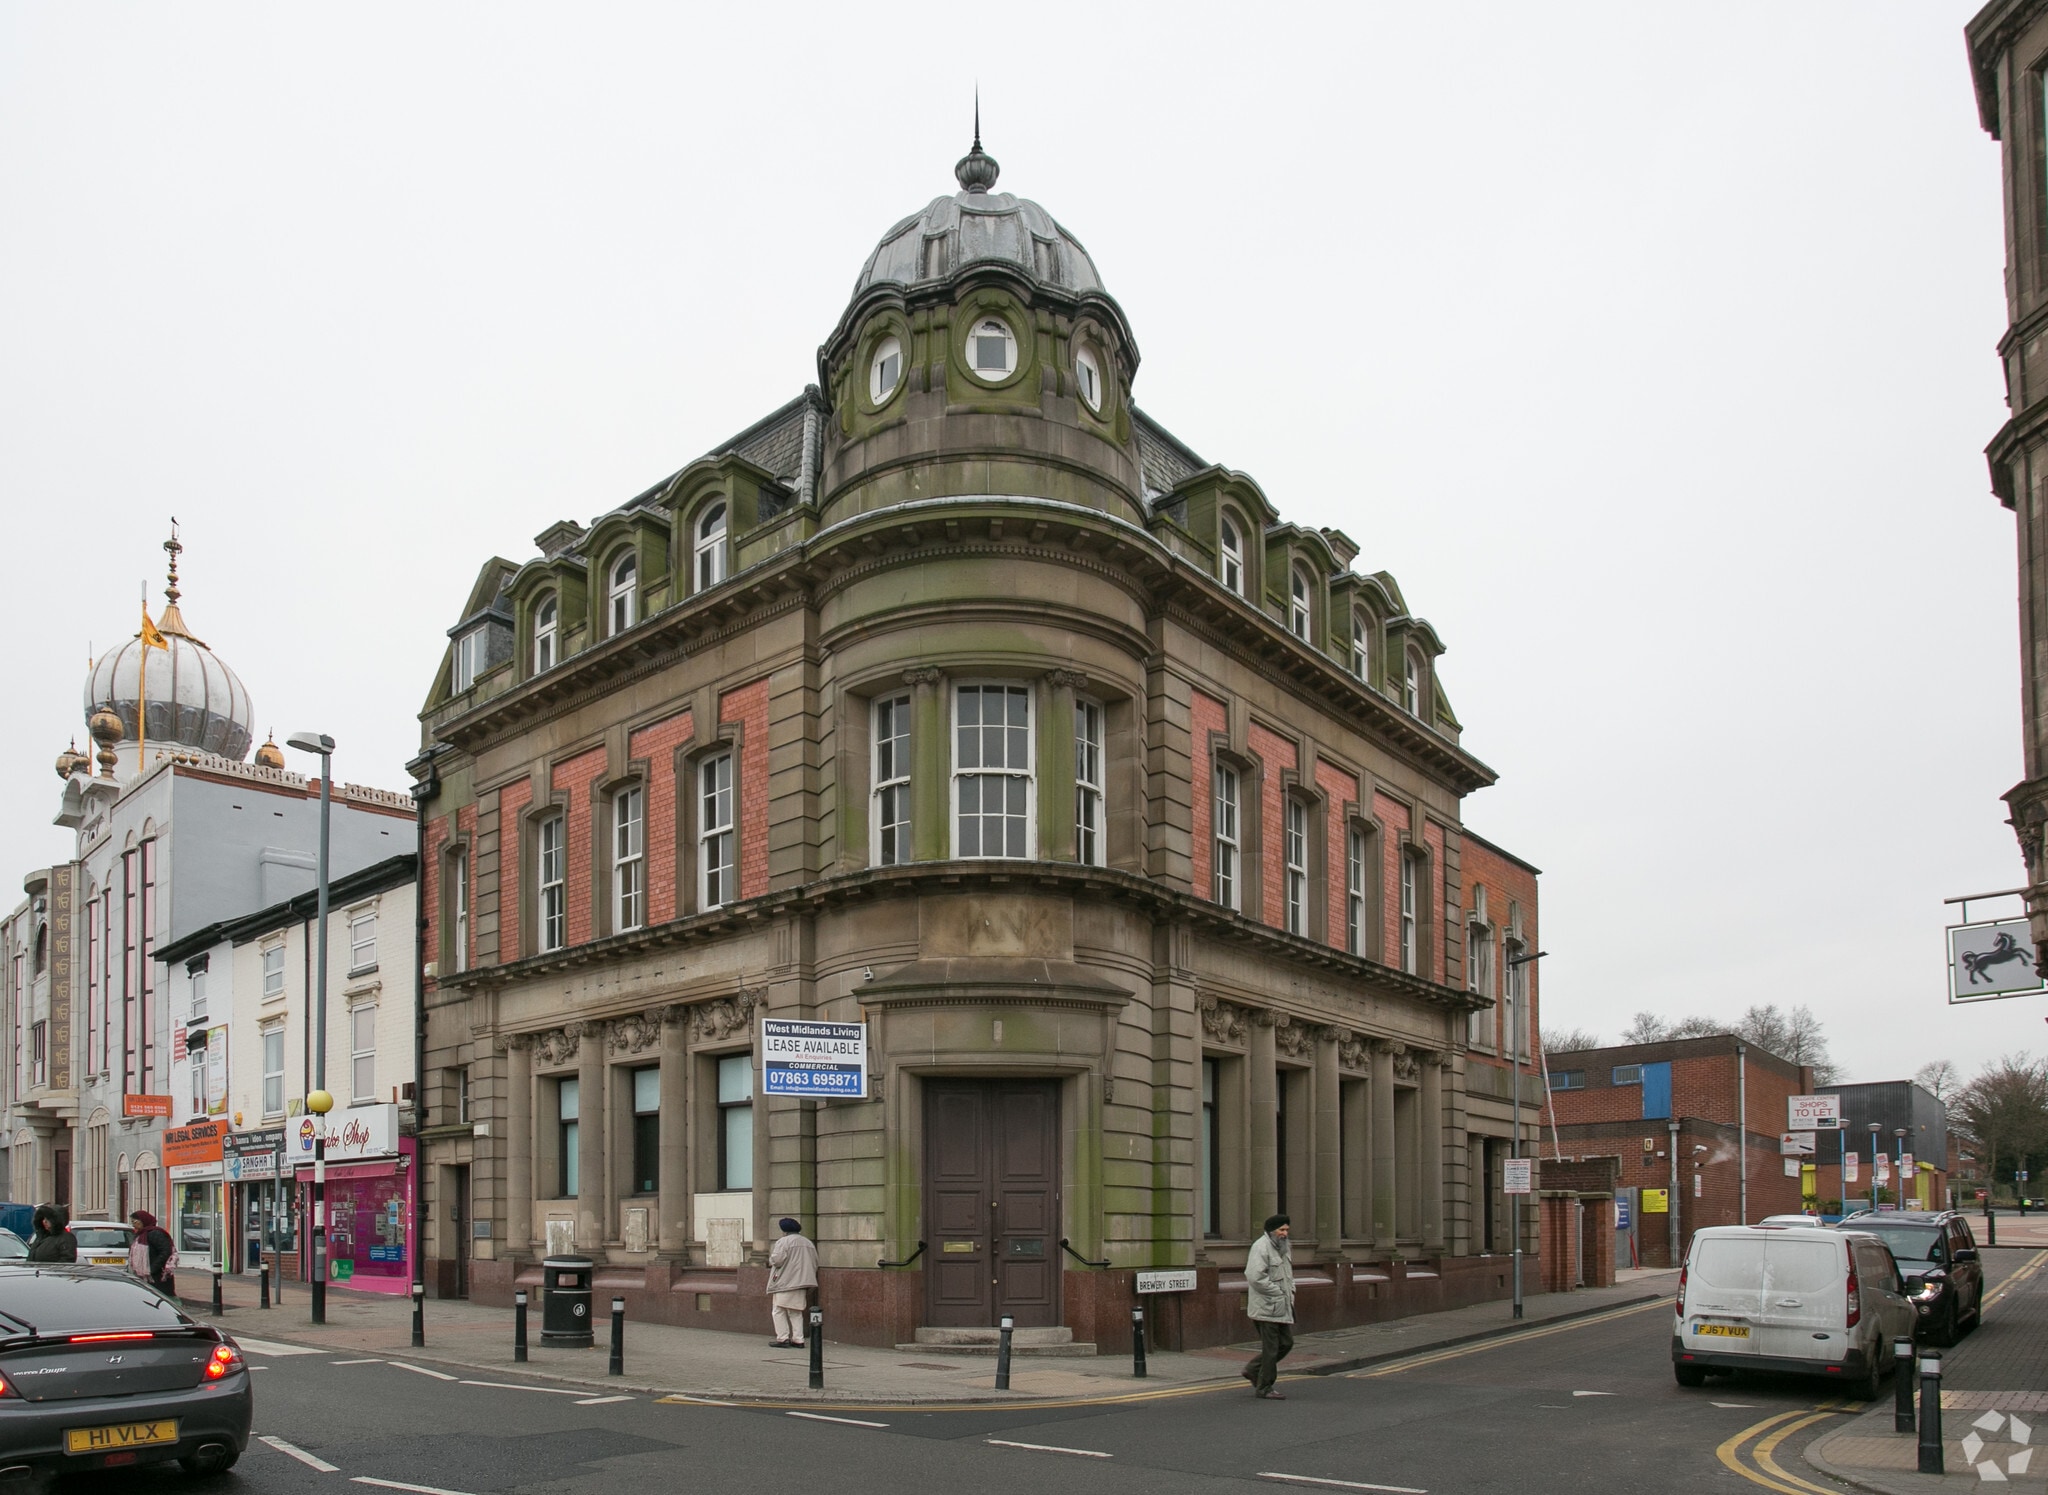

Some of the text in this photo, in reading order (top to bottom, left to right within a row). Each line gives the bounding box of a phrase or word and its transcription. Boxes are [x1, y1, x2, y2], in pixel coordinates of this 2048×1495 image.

[767, 1023, 860, 1039] West Midlands Living
[767, 1039, 860, 1055] LEASE AVAILABLE
[805, 1053, 833, 1061] Enquiries
[788, 1062, 839, 1071] COMMERCIAL
[770, 1071, 858, 1087] 07863 695871
[1799, 1101, 1828, 1109] SHOPS
[1795, 1108, 1833, 1117] TO LET
[165, 1124, 218, 1144] NRI LEGAL SERVICES
[343, 1118, 370, 1154] Shop
[242, 1155, 268, 1169] SANGHA
[1140, 1279, 1190, 1290] BREWERY STREET
[1699, 1324, 1748, 1337] FJ67 VUX
[116, 1423, 159, 1442] VLX
